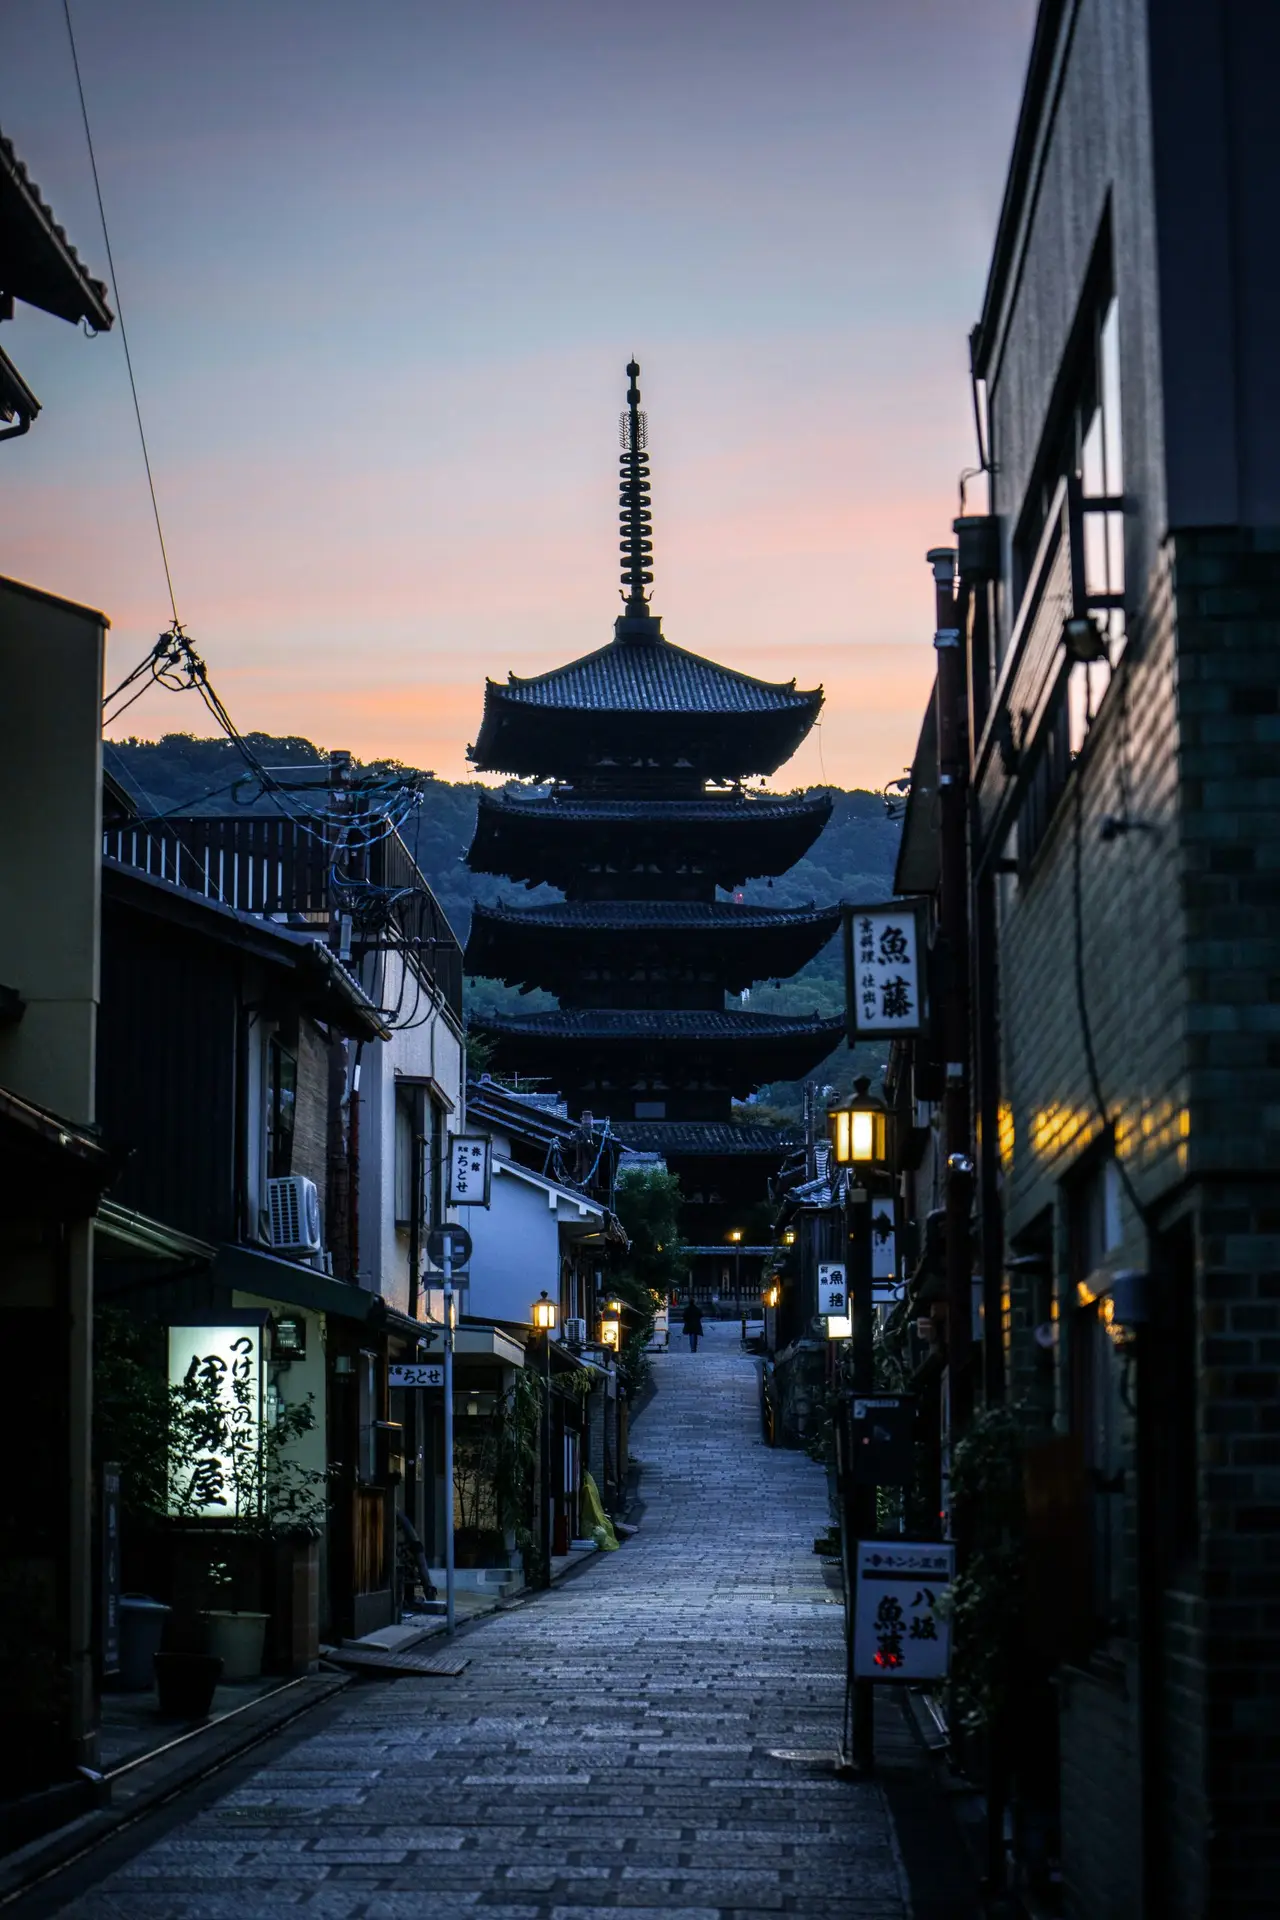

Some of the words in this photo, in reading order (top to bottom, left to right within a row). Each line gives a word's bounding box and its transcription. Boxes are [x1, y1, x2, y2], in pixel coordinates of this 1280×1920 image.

[878, 925, 914, 1018] 魚藤
[456, 1155, 469, 1194] ちとせ
[471, 1147, 482, 1172] 旅館
[404, 1369, 441, 1384] ちとせ
[886, 1556, 947, 1568] キンシ正宗
[910, 1588, 938, 1641] 八坂
